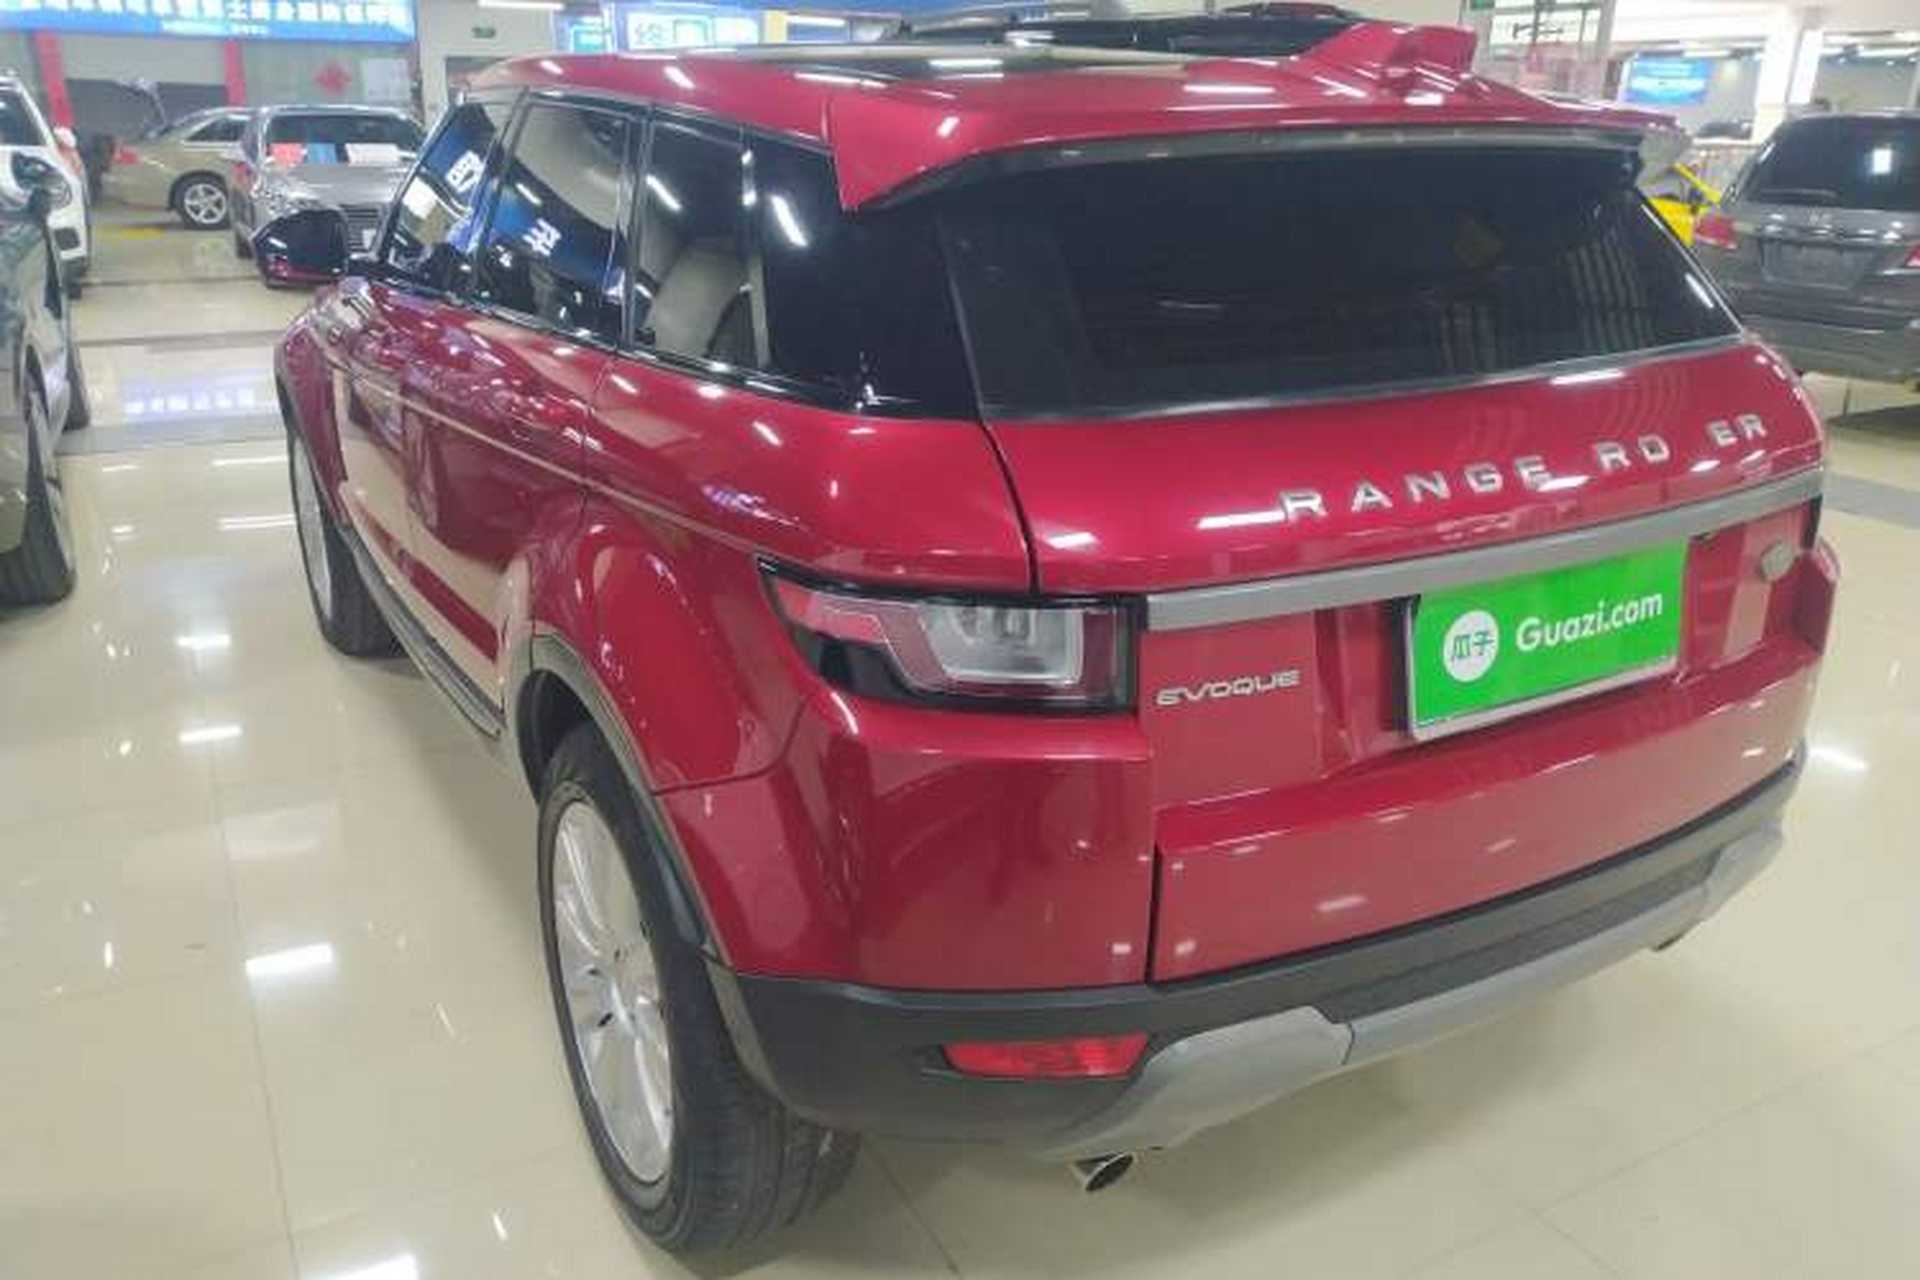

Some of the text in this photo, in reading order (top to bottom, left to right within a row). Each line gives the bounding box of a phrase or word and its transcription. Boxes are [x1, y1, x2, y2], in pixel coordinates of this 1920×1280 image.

[1280, 413, 1767, 519] RANGE ROER
[1516, 593, 1663, 652] Guazi.com
[1451, 631, 1494, 662] 瓜子
[1156, 669, 1299, 705] EVOQUE
